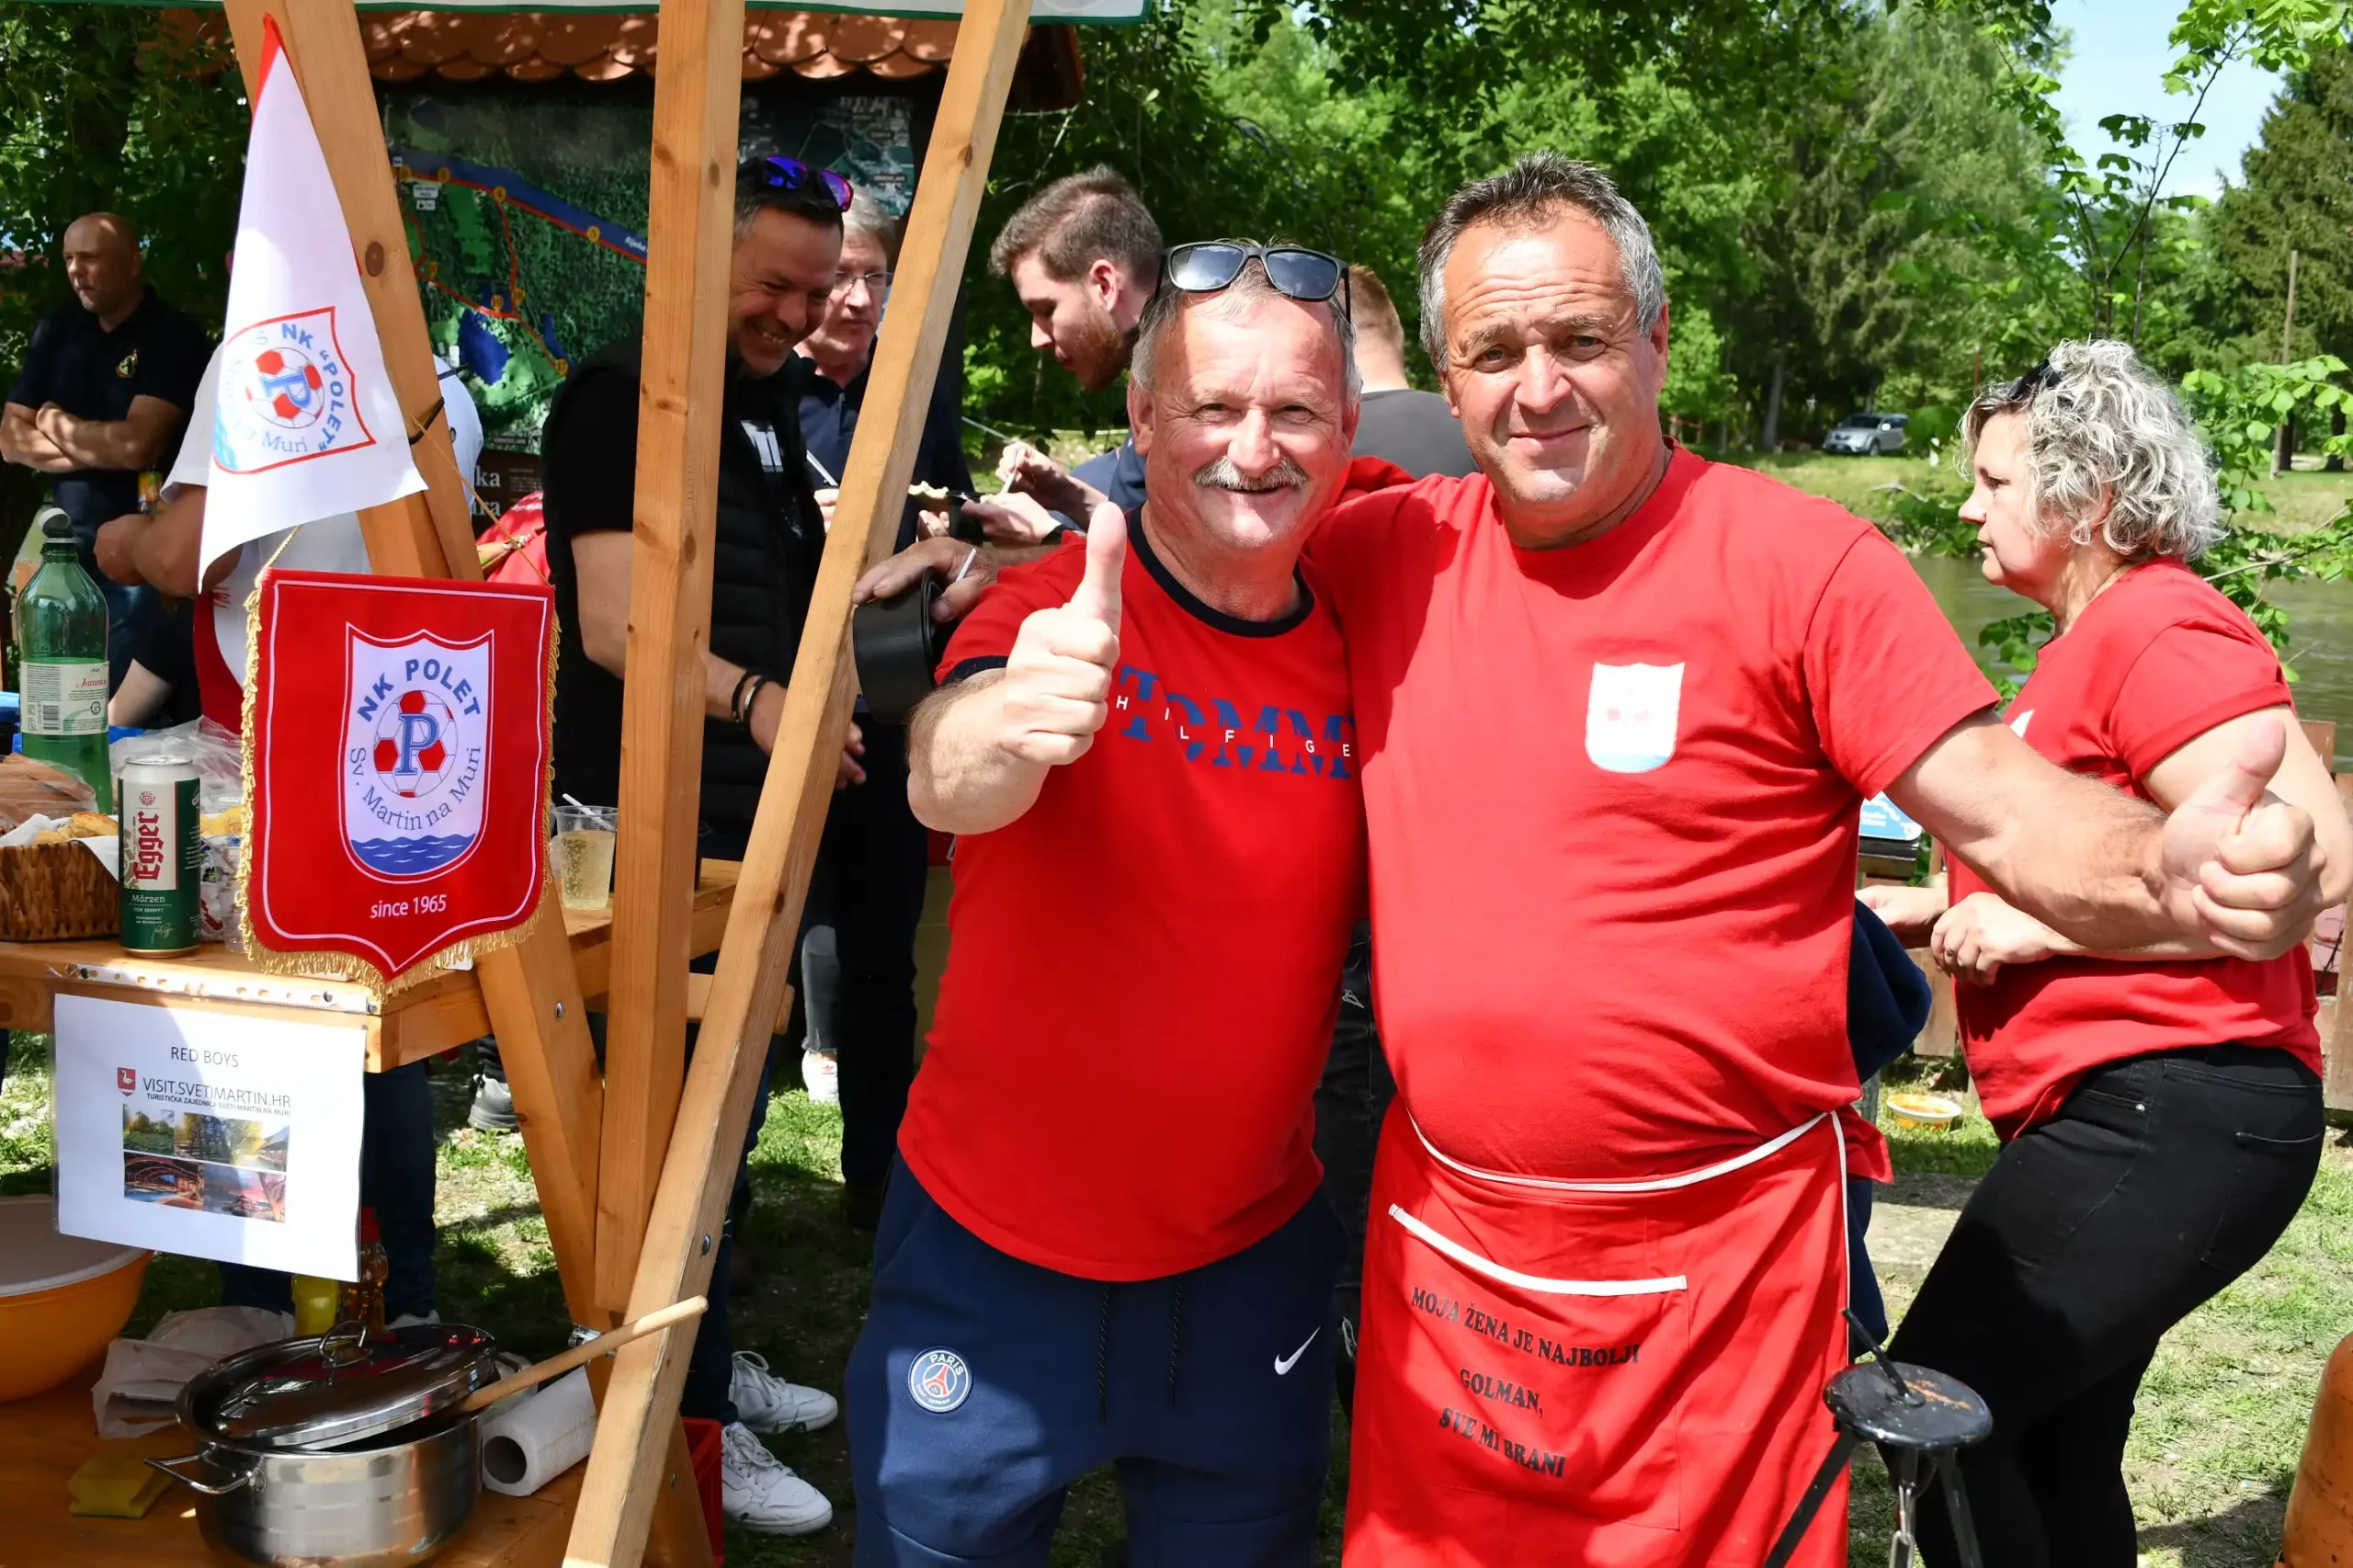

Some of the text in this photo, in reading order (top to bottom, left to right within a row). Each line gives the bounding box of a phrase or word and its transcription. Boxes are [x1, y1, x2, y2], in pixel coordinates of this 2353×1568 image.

[281, 323, 313, 350] NK
[259, 366, 311, 408] P
[262, 430, 308, 452] Muri
[358, 658, 481, 722] NK POLET
[1116, 696, 1351, 756] HILFIGE
[1119, 664, 1357, 778] TOMM
[395, 712, 439, 777] P
[362, 785, 423, 831] Martin
[426, 802, 452, 827] na
[449, 746, 481, 803] Muri
[132, 811, 164, 881] Egger
[131, 894, 165, 903] Märzen
[370, 894, 447, 919] since 1965
[171, 1046, 239, 1068] RED BOYS
[142, 1077, 290, 1108] VISIT.SVETIMARTIN.HR
[183, 1097, 217, 1108] ZAJEDNICA
[236, 1105, 262, 1113] MARTIN
[1412, 1287, 1640, 1368] MOJA ŽENA JE NAJBOLJI
[930, 1354, 963, 1375] PARIS
[1460, 1369, 1543, 1418] GOLMAN,
[1439, 1407, 1566, 1479] SVE MI BRANI
